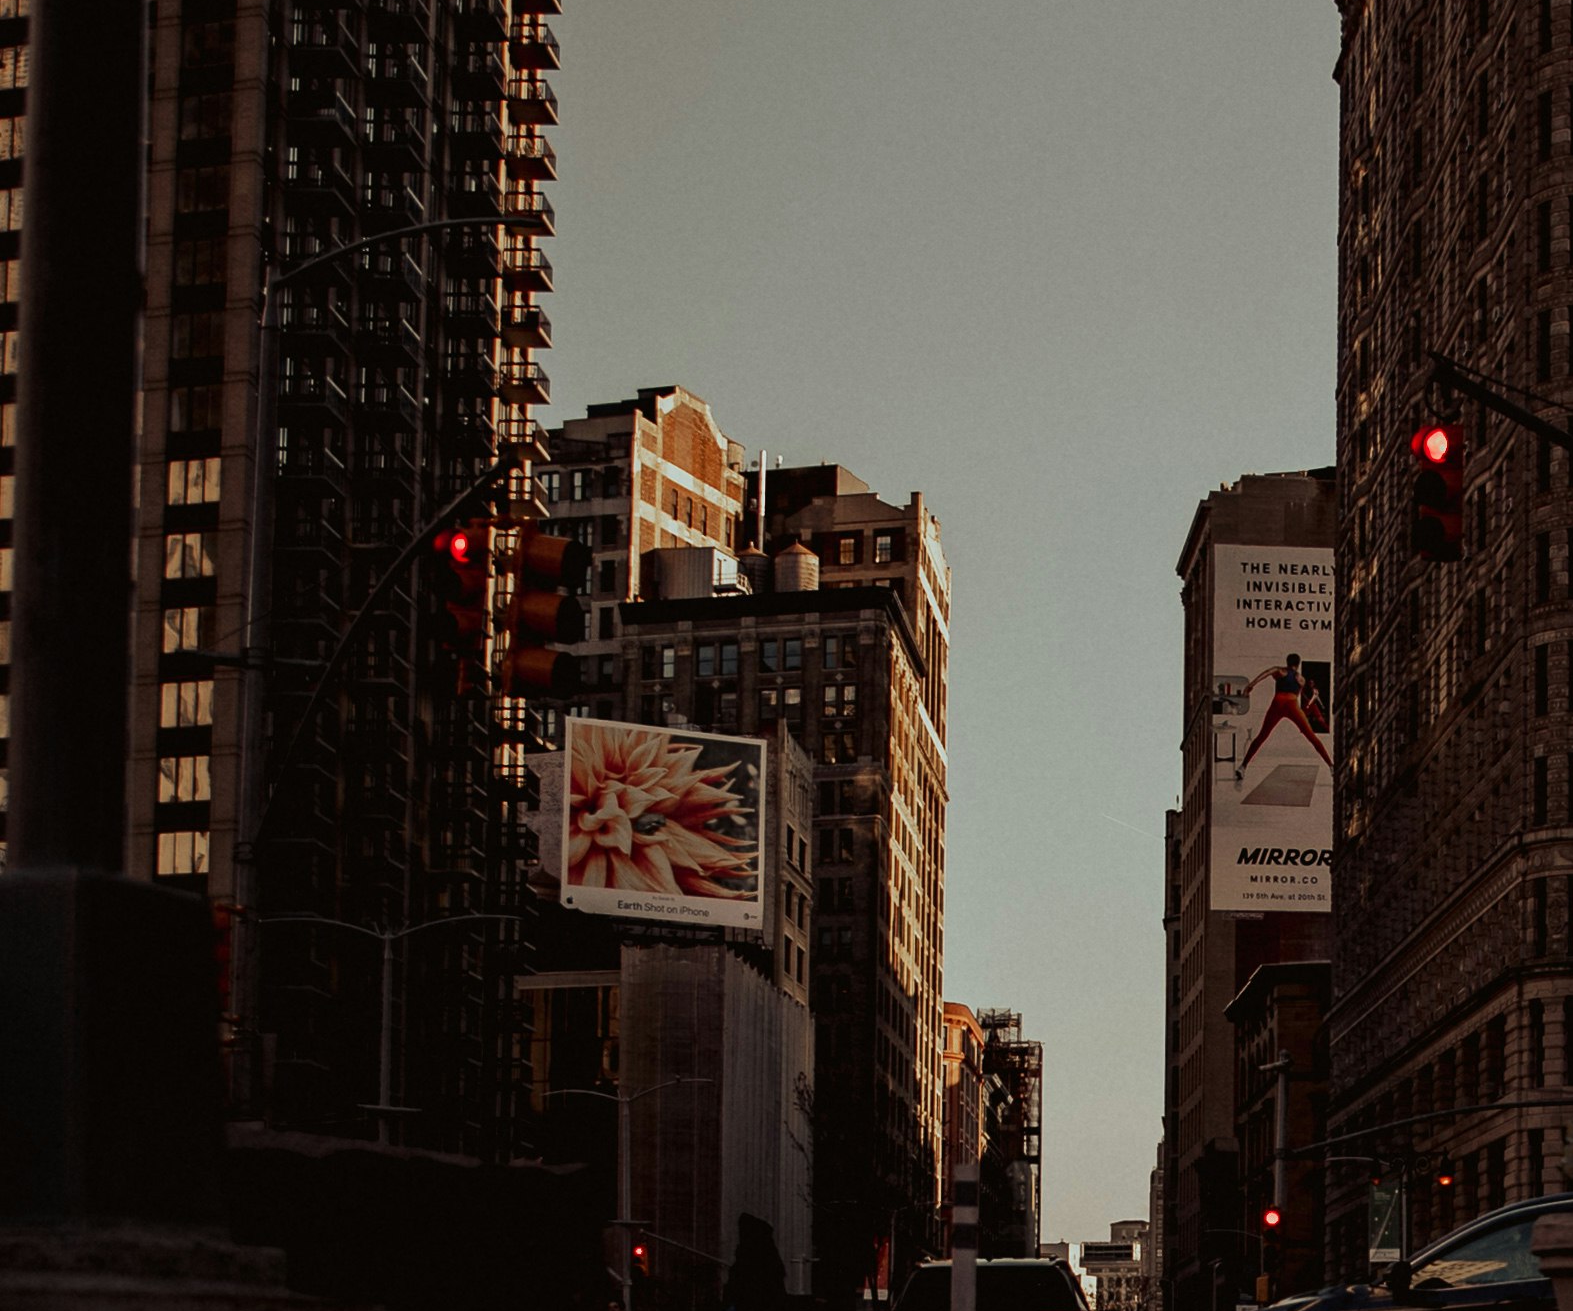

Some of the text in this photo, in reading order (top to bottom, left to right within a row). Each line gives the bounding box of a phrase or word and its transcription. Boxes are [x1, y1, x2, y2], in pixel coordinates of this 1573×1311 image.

[1241, 562, 1271, 574] THE
[1246, 581, 1333, 595] INVISIBLE,
[1236, 598, 1331, 612] INTERACTIV
[1246, 617, 1332, 631] HOME GYM
[1237, 847, 1334, 867] MIRROR
[1250, 875, 1318, 884] MIRROR.CO
[617, 899, 643, 911] Earth
[644, 902, 665, 913] Shot
[667, 907, 678, 915] on
[679, 906, 710, 918] iPhone
